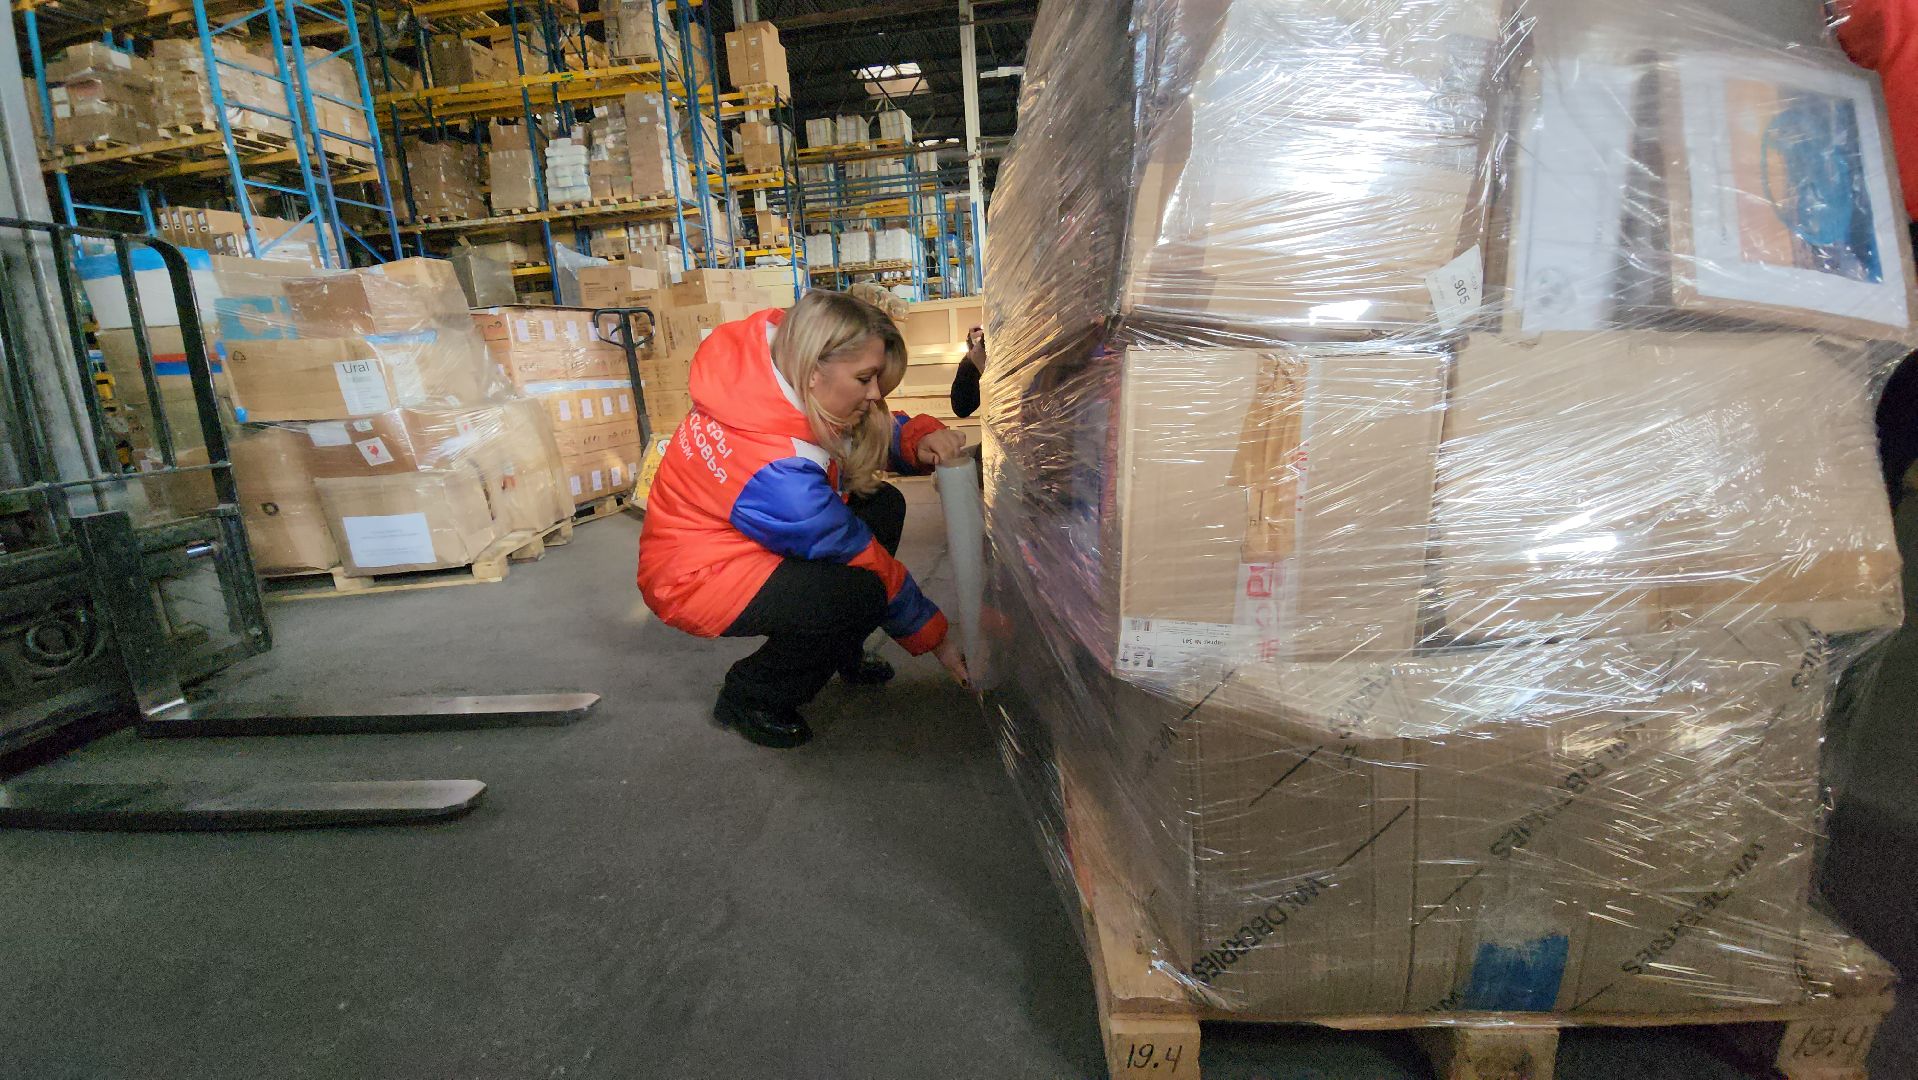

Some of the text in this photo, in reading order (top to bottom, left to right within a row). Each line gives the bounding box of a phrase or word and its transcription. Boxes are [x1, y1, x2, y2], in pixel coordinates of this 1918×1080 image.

[1454, 279, 1470, 305] 905
[342, 361, 370, 374] Ural
[690, 412, 728, 484] СКОВЬЯ
[705, 418, 733, 459] ЕРЫ
[1126, 1042, 1183, 1073] 19.4
